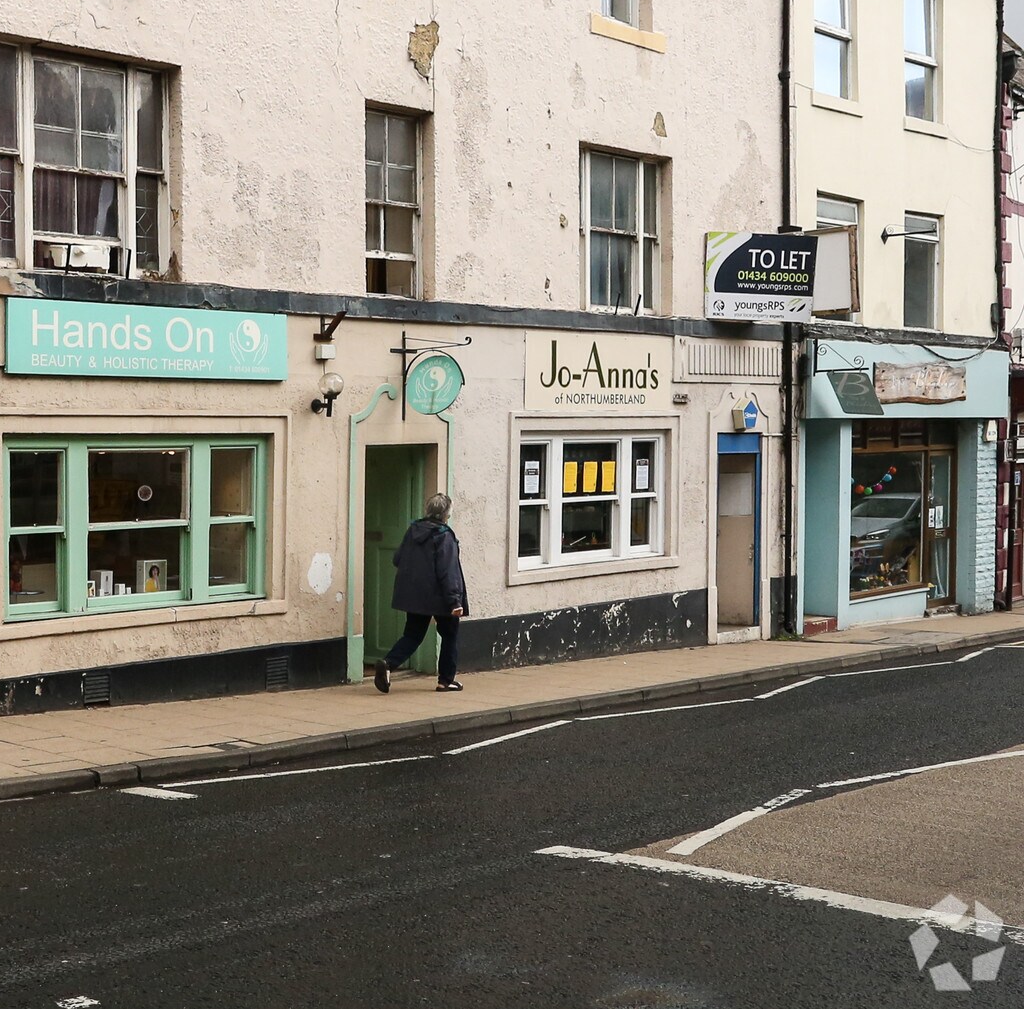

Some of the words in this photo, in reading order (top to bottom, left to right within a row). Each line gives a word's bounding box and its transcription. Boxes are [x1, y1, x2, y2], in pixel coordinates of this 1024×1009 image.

[748, 249, 775, 269] TO
[780, 250, 811, 270] LET
[737, 271, 767, 281] 01434
[769, 272, 809, 283] 609000
[737, 282, 808, 291] www.youngsrps.com
[734, 301, 785, 312] youngsRPS
[32, 309, 152, 351] Hands
[165, 317, 214, 353] On
[31, 353, 82, 368] BEAUTY
[88, 356, 97, 368] &
[103, 356, 158, 370] HOLISTIC
[161, 358, 214, 372] THERAPY
[540, 339, 659, 390] Jo-Anna's
[554, 392, 564, 405] of
[566, 393, 646, 405] NORTHUMBERLAND
